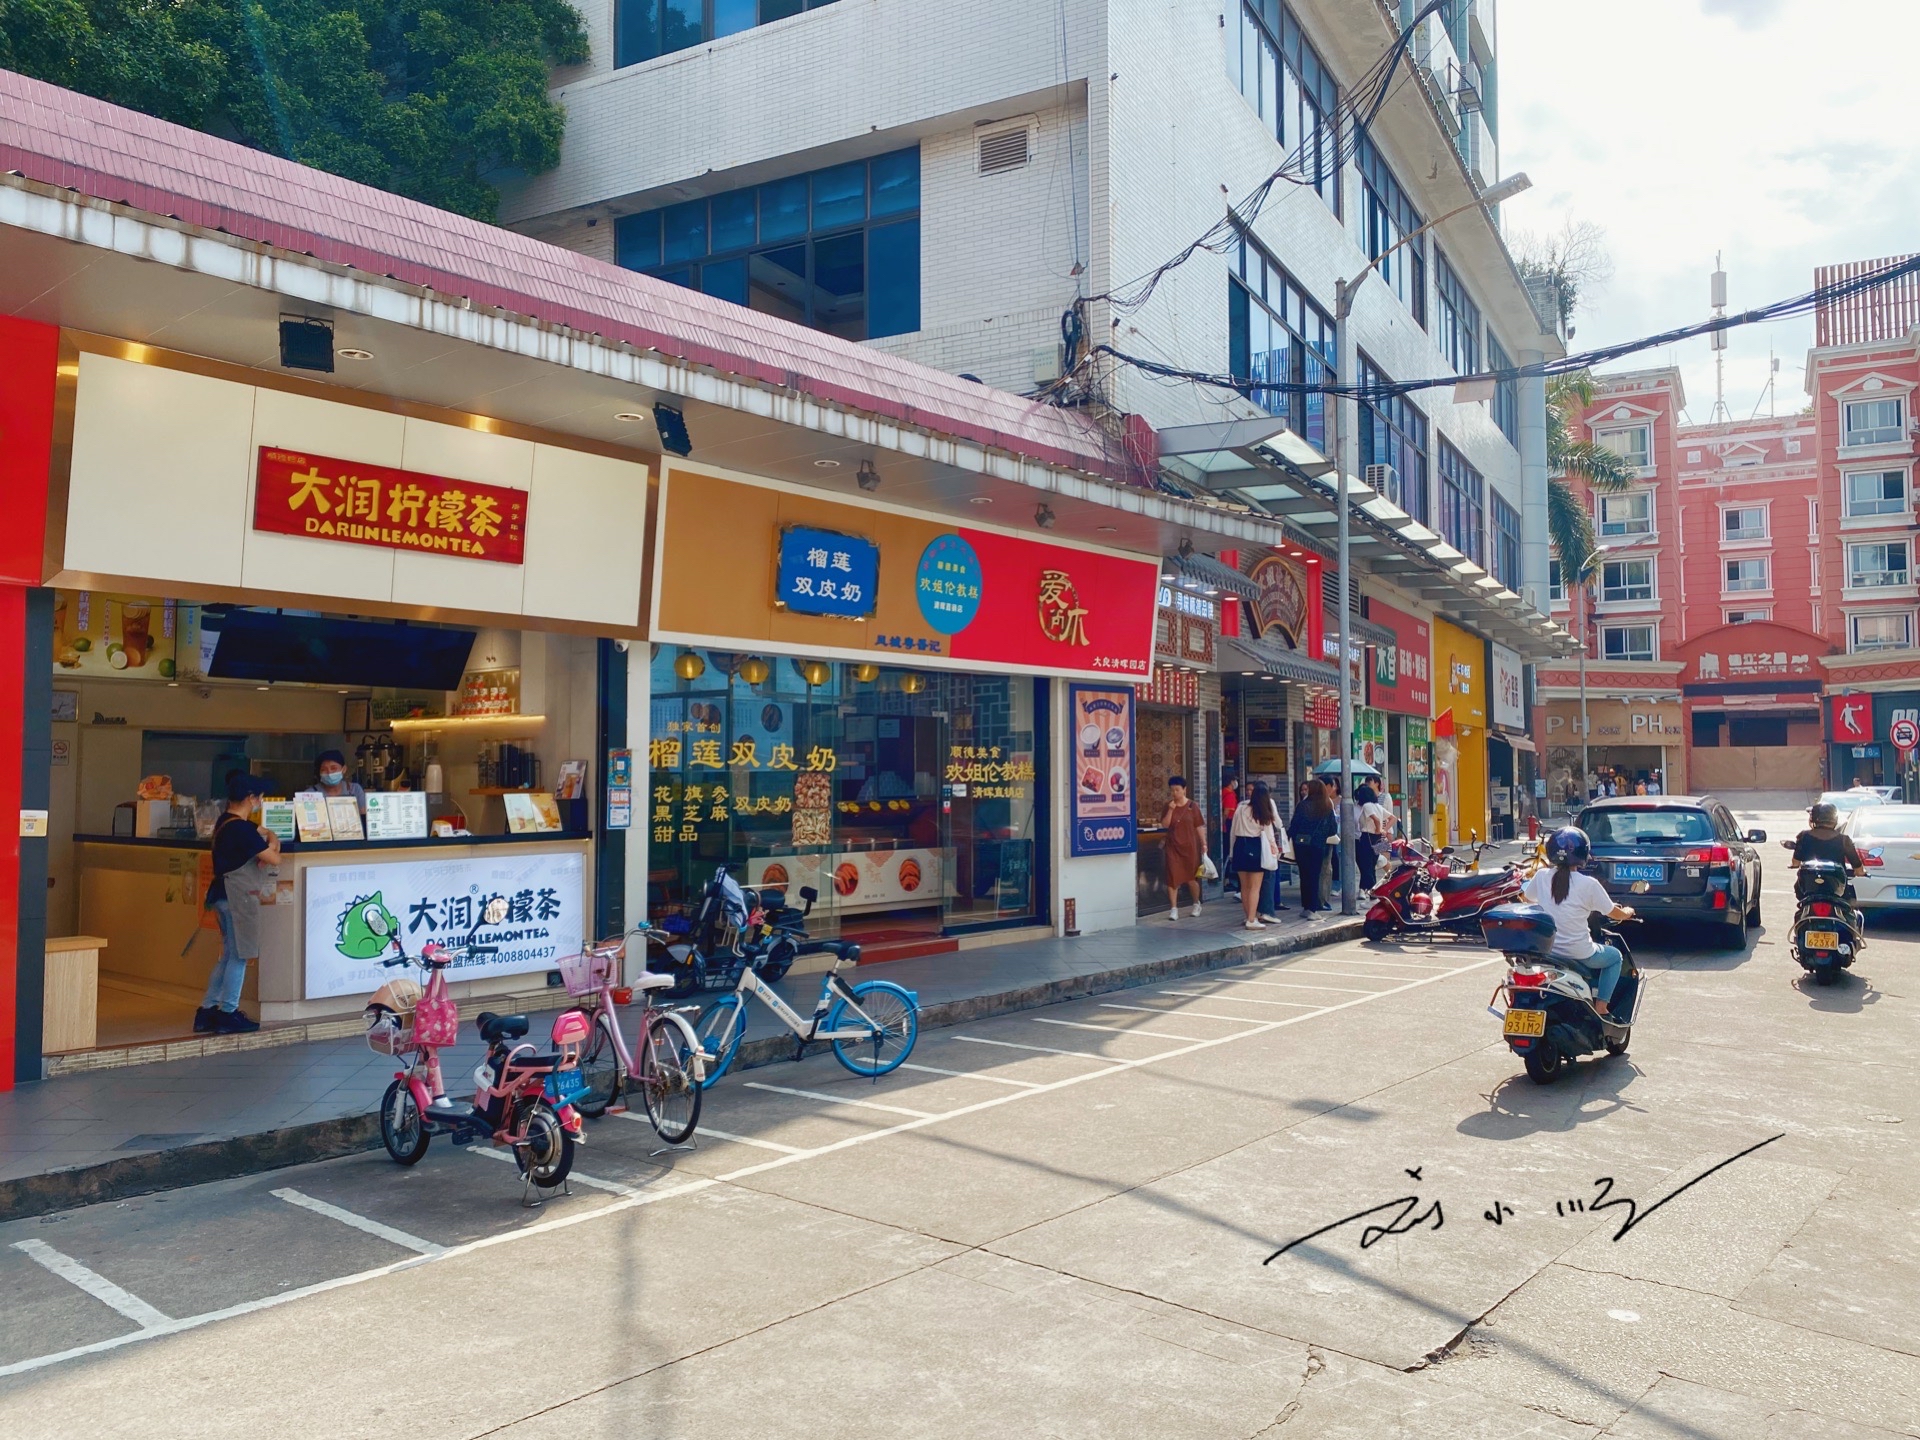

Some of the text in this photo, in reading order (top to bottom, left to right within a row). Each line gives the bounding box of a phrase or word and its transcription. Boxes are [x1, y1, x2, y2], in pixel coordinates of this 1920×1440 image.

[288, 467, 503, 537] 大润柠檬茶
[305, 517, 485, 555] DARUNLEMONTEA
[806, 547, 853, 573] 榴莲
[792, 576, 862, 603] 双皮奶
[920, 577, 979, 599] 欢姐伦教糕
[1092, 656, 1147, 671] 大良清晖园店
[666, 720, 722, 734] 独家首创
[1631, 714, 1663, 734] PH
[649, 738, 837, 772] 榴莲双皮奶
[945, 761, 1036, 783] 欢姐伦教糕
[732, 795, 792, 812] 双皮奶
[653, 824, 699, 844] 甜品
[1507, 1021, 1541, 1035] 931M2
